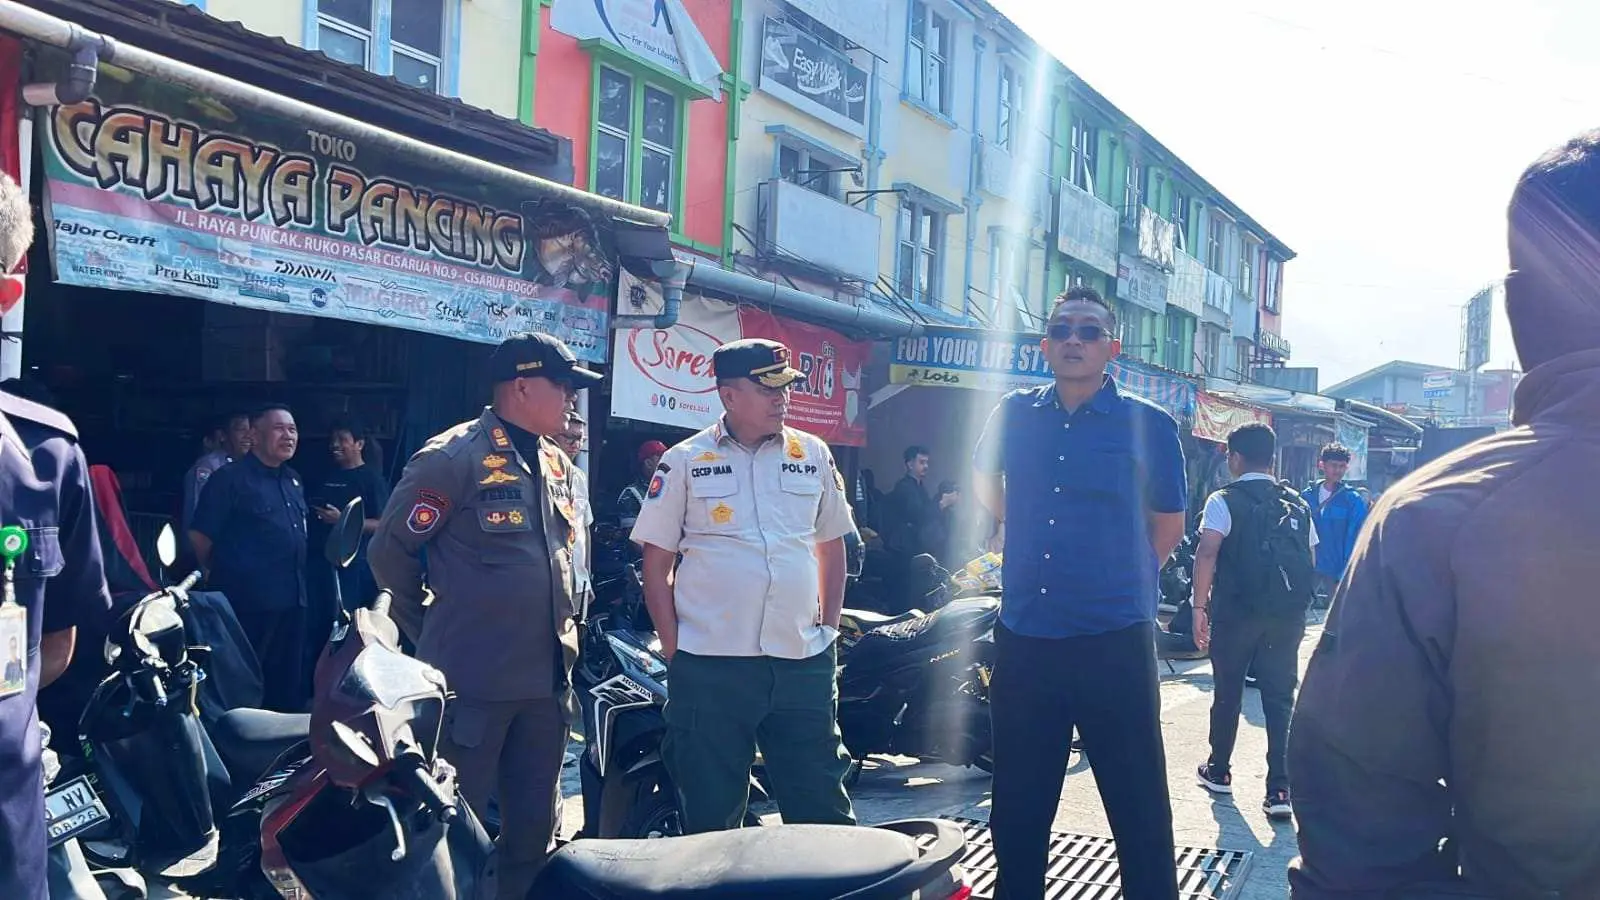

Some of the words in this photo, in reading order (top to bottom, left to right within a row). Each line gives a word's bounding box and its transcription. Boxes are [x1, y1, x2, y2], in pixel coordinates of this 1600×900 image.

[307, 129, 357, 161] TOKO
[50, 97, 317, 228] CAHAYA
[327, 164, 526, 272] PANCING
[102, 229, 157, 248] Craft
[175, 210, 194, 227] JL.
[198, 214, 237, 237] RAYA
[304, 236, 340, 255] RUKO
[342, 244, 381, 263] PASAR
[383, 252, 431, 276] CISARUA
[432, 264, 458, 281] NO.9
[464, 271, 506, 291] CISARUA
[155, 264, 178, 279] Pro
[183, 268, 219, 286] Katsu
[435, 301, 469, 319] Strike
[484, 301, 508, 318] YGK
[896, 335, 928, 362] FOR
[932, 337, 978, 367] YOUR
[981, 340, 1016, 370] LIFE
[1018, 344, 1057, 375] ST
[786, 351, 835, 400] RIO
[922, 369, 960, 383] Lois
[691, 466, 712, 478] CECEP
[782, 463, 803, 474] POL
[804, 464, 817, 475] PP
[621, 676, 652, 699] HONDA
